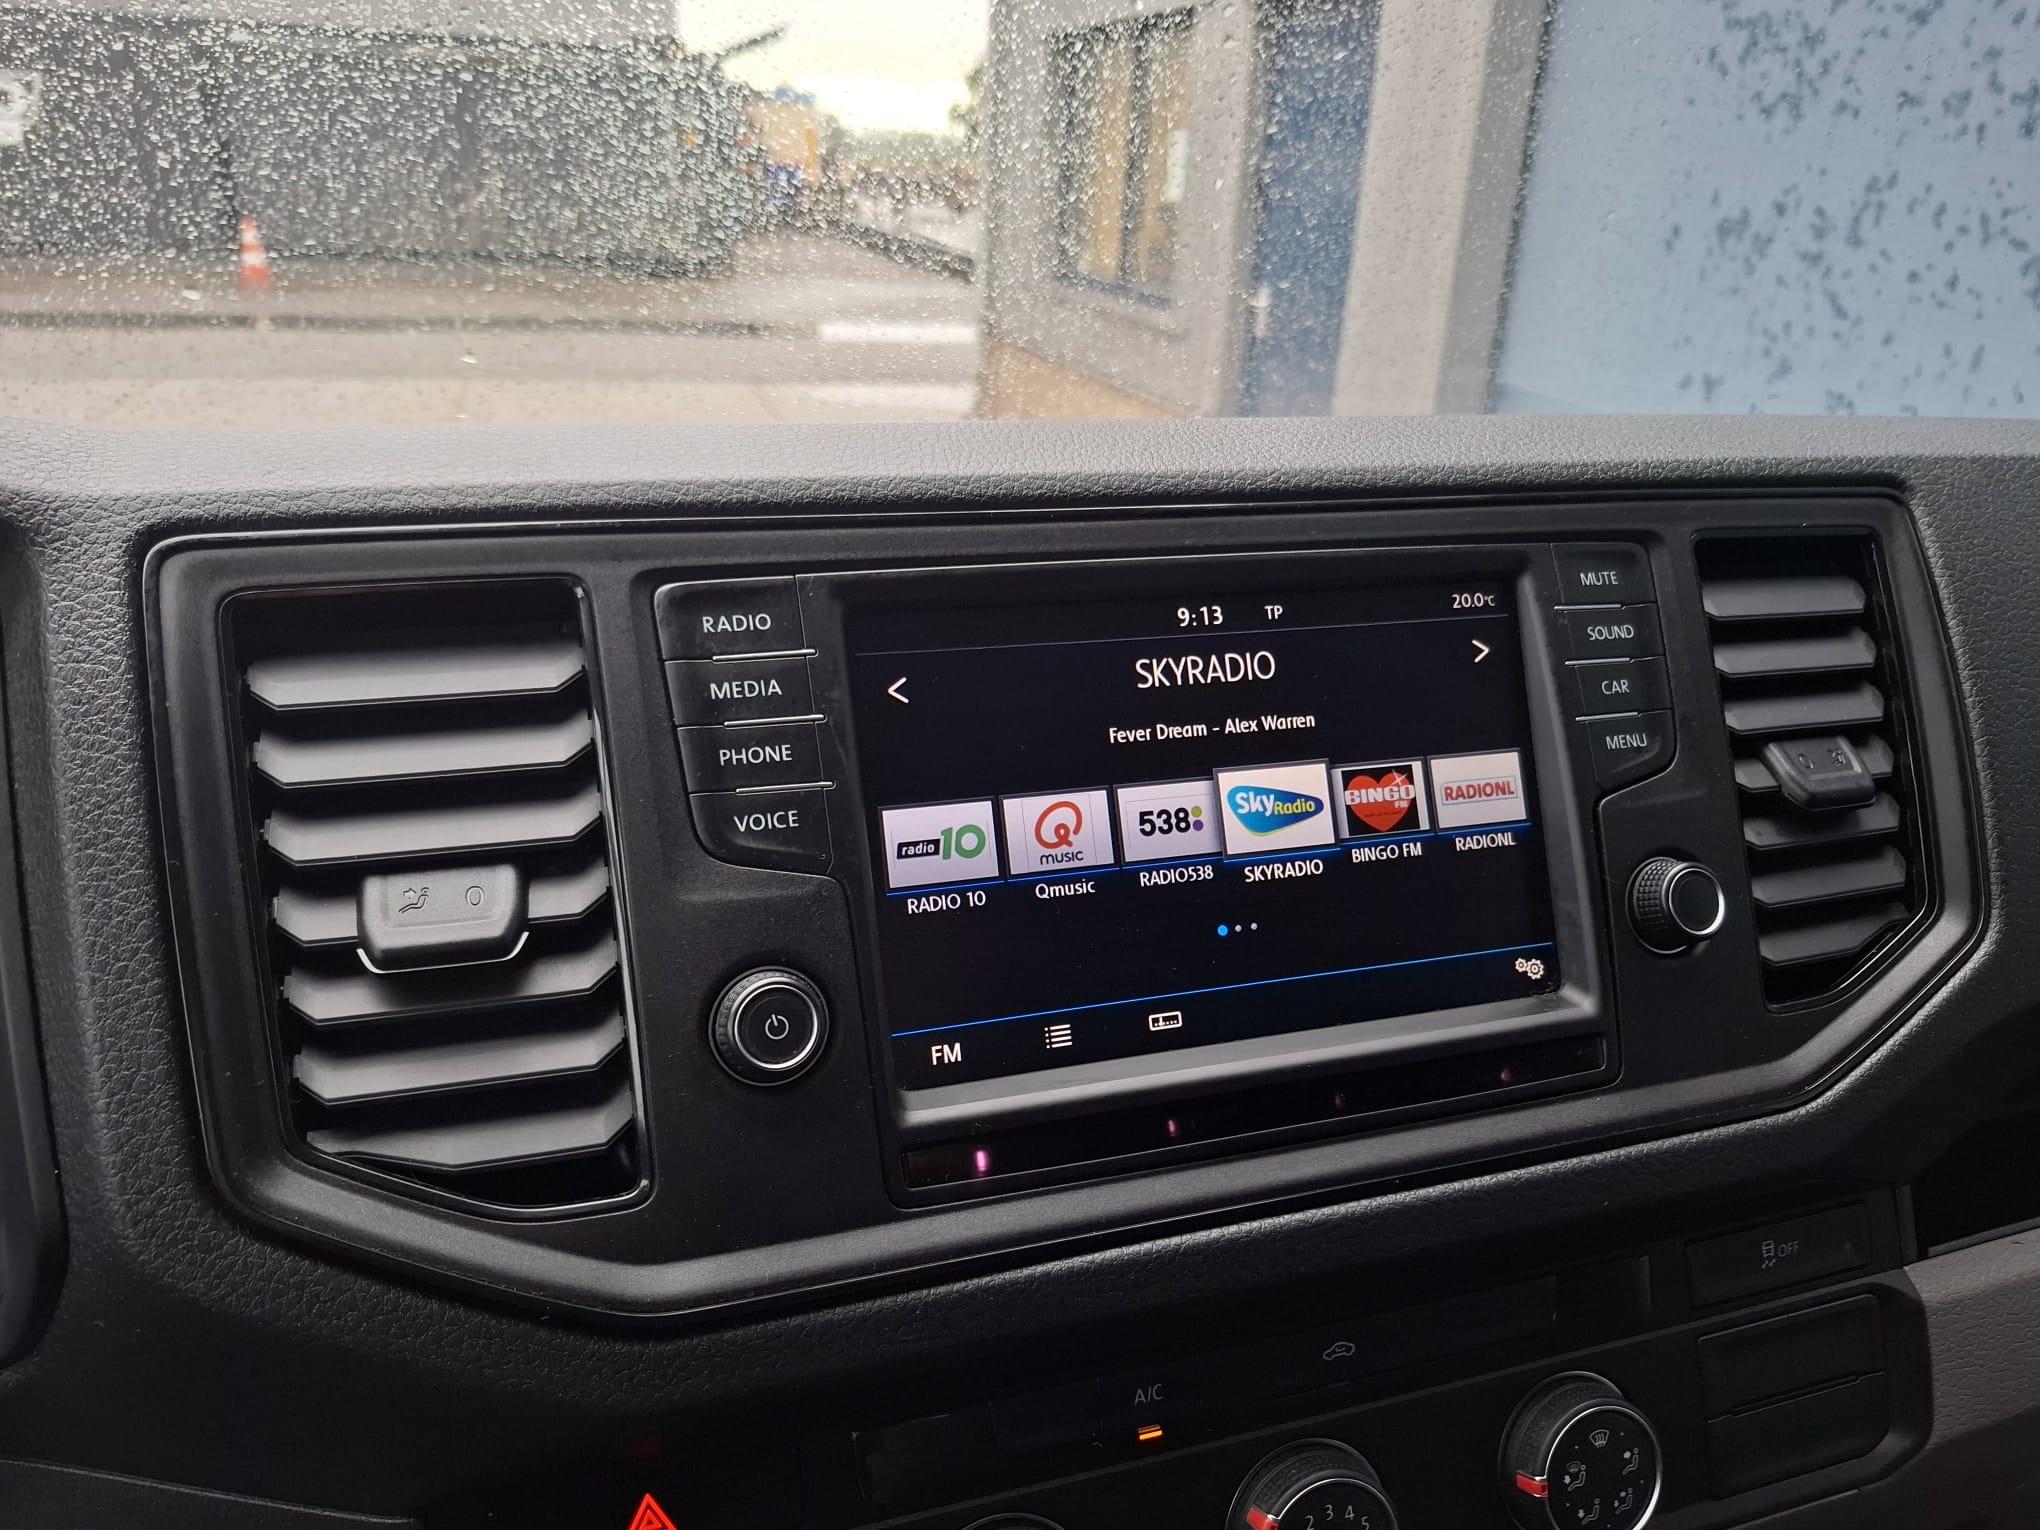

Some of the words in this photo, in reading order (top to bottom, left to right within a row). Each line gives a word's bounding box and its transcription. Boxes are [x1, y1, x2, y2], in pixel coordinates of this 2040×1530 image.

[1580, 572, 1618, 585] MUTE
[1452, 592, 1495, 609] 20.0°C
[1178, 606, 1222, 626] 9:13
[1265, 605, 1282, 619] TP
[703, 614, 771, 632] RADIO
[1587, 625, 1633, 640] SOUND
[1136, 651, 1275, 688] SKYRADIO
[710, 680, 782, 699] MEDIA
[1602, 680, 1629, 694] CAR
[1110, 728, 1151, 743] Fever
[1157, 724, 1207, 739] Dream
[1225, 718, 1258, 734] Alex
[1261, 715, 1315, 730] Warren
[1606, 733, 1647, 749] MENU
[720, 745, 792, 765] PHONE
[1344, 783, 1416, 807] BINGO
[1394, 800, 1410, 810] FM
[1443, 781, 1515, 801] RADIONL
[734, 811, 798, 832] VOICE
[1034, 800, 1083, 850] Q
[901, 842, 936, 857] radio
[939, 825, 986, 860] 10
[1455, 832, 1516, 851] RADIONL
[1352, 845, 1398, 862] BINGO
[1403, 842, 1422, 857] FM
[1140, 865, 1214, 887] RADIO538
[1244, 859, 1324, 883] SKYRADIO
[1035, 879, 1096, 899] Qmusic
[907, 894, 961, 915] RADIO
[967, 891, 985, 906] 10
[932, 1043, 961, 1065] FM
[1778, 1240, 1800, 1258] OFF
[1135, 1384, 1162, 1405] A/C
[1304, 1515, 1315, 1530] 2
[1323, 1504, 1334, 1521] 3
[1344, 1504, 1355, 1520] 4
[1361, 1516, 1370, 1530] 5
